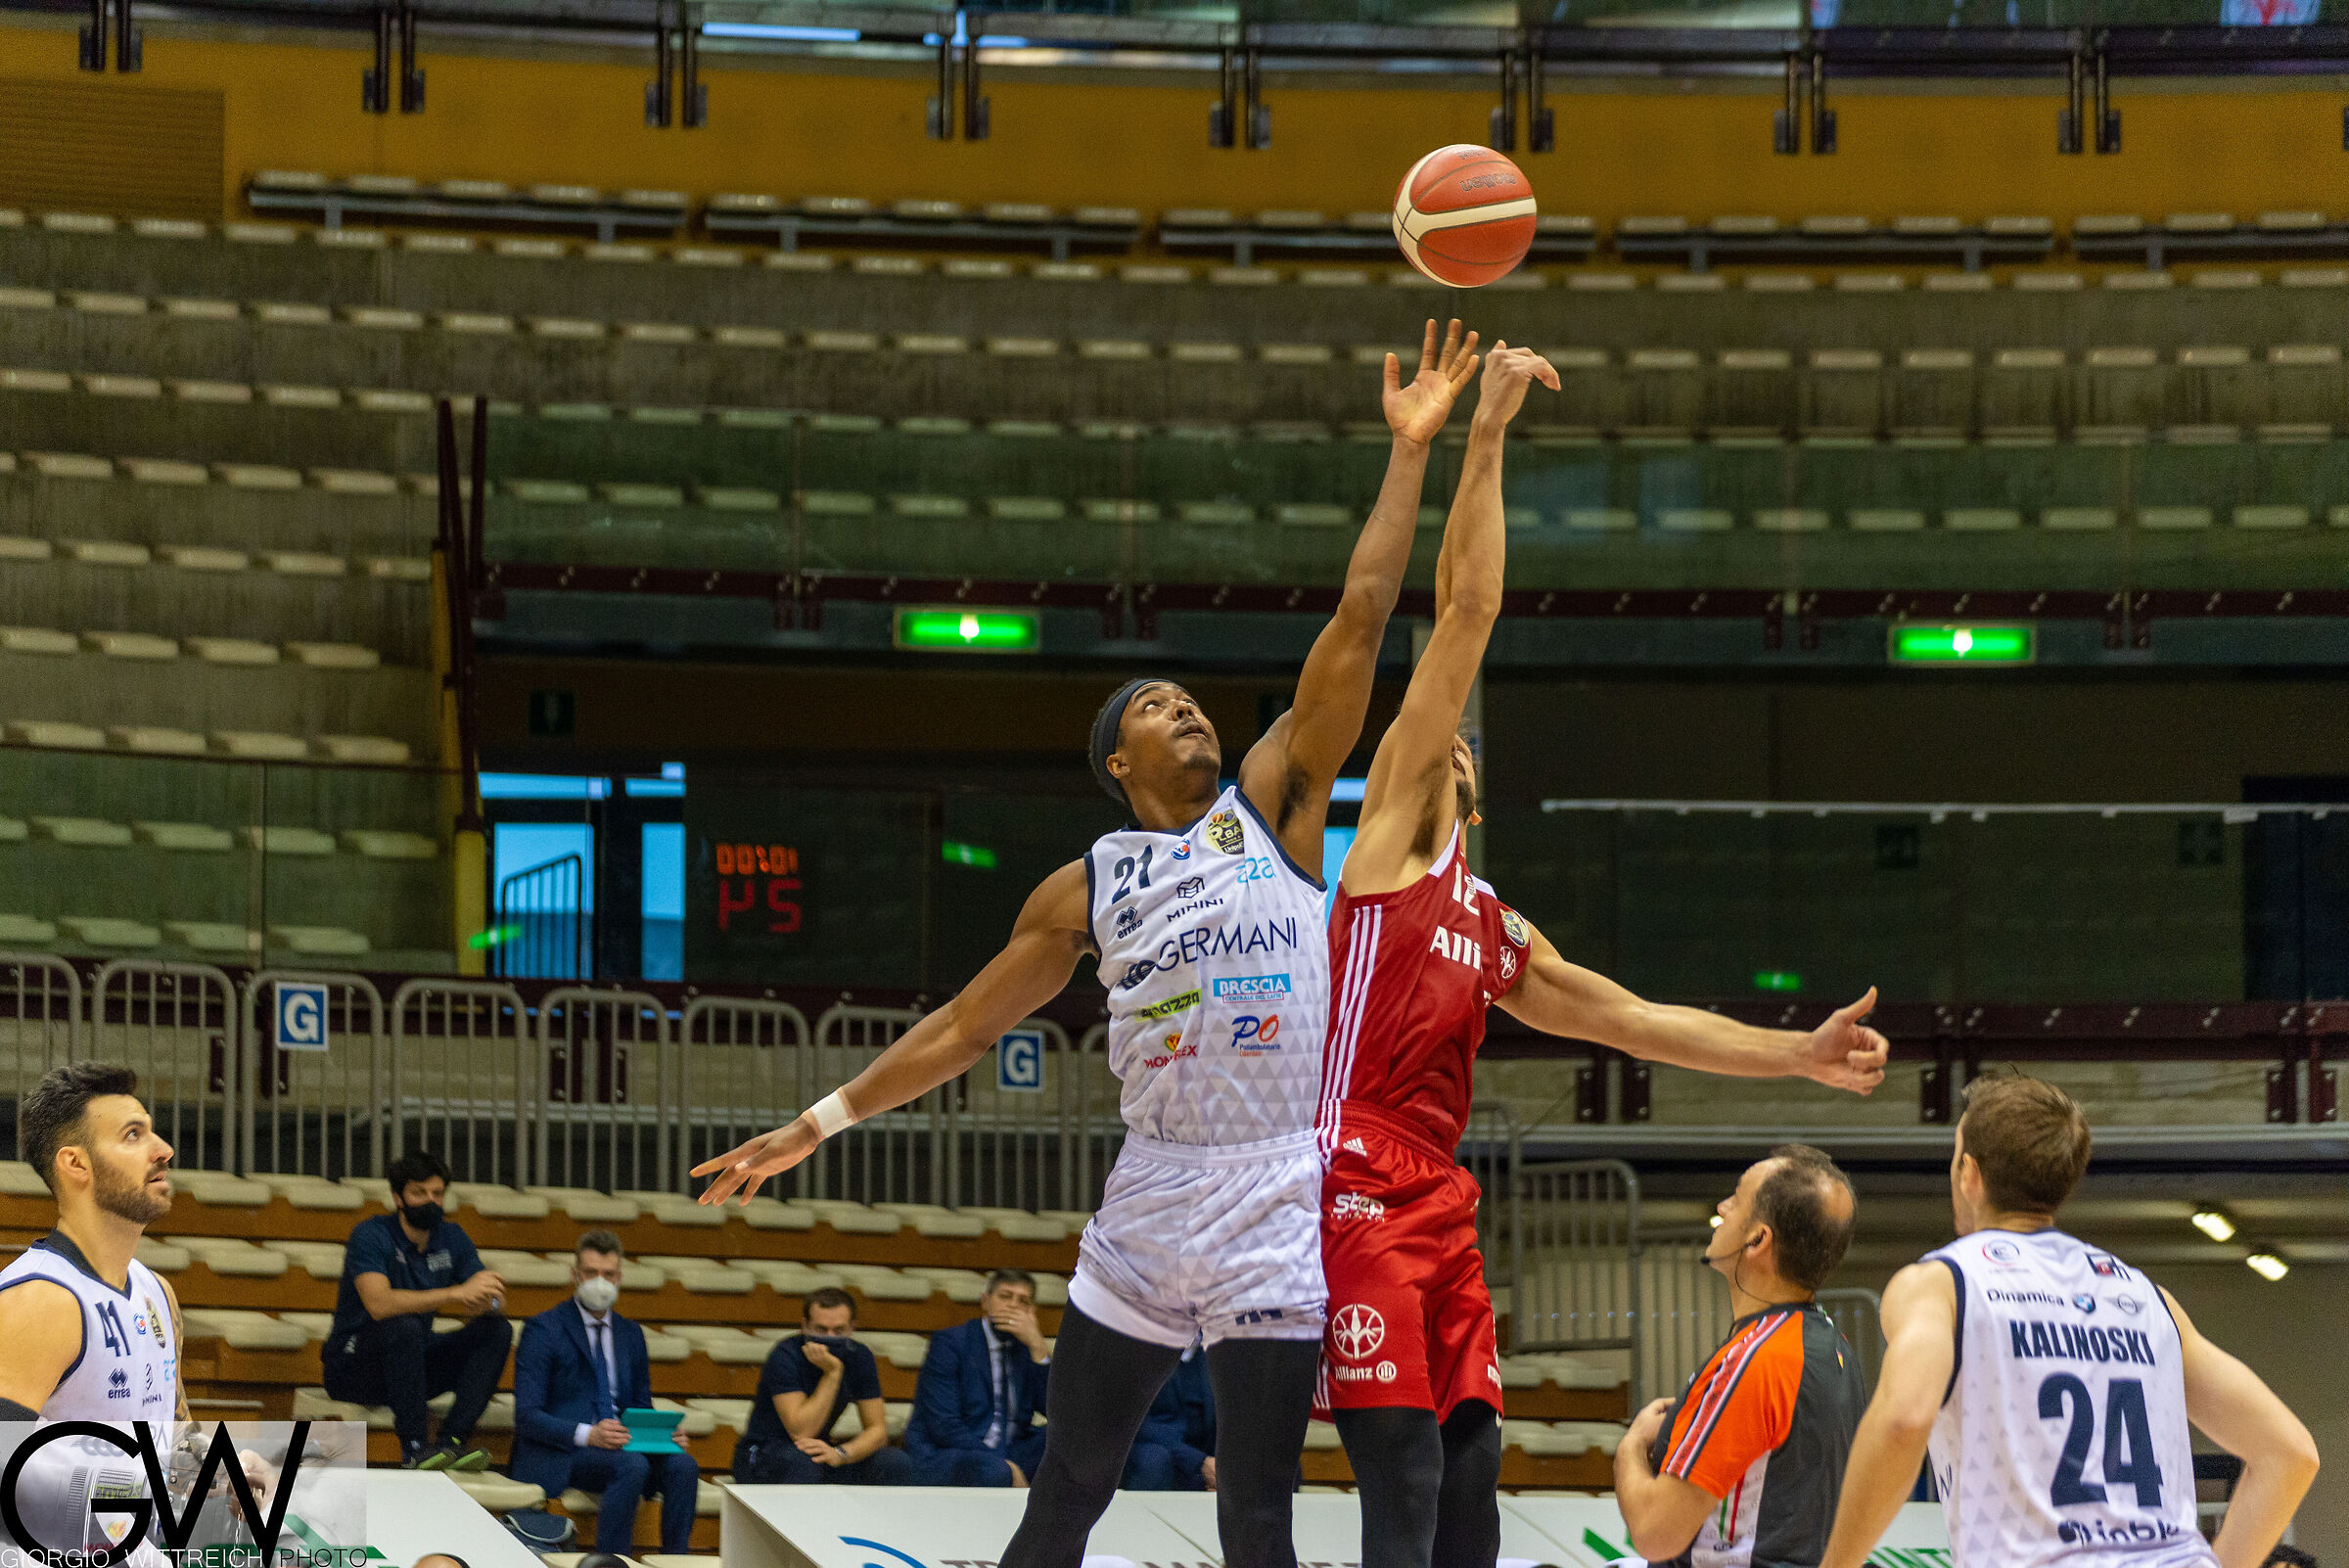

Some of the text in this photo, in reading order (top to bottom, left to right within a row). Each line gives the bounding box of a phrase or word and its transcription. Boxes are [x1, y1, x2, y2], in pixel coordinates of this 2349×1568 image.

[1112, 845, 1153, 904] 21
[1235, 856, 1276, 883] a2a
[1167, 898, 1223, 922] MININI
[1156, 917, 1297, 971] GERMANI
[1220, 977, 1286, 995] BRESCIA
[284, 992, 319, 1042] G
[1004, 1038, 1036, 1084] G
[1987, 1289, 2065, 1308] Dinamica
[95, 1300, 131, 1357] 41
[2009, 1320, 2156, 1366] KALINOSKI
[1335, 1365, 1372, 1381] Allianz
[2038, 1371, 2164, 1510] 24
